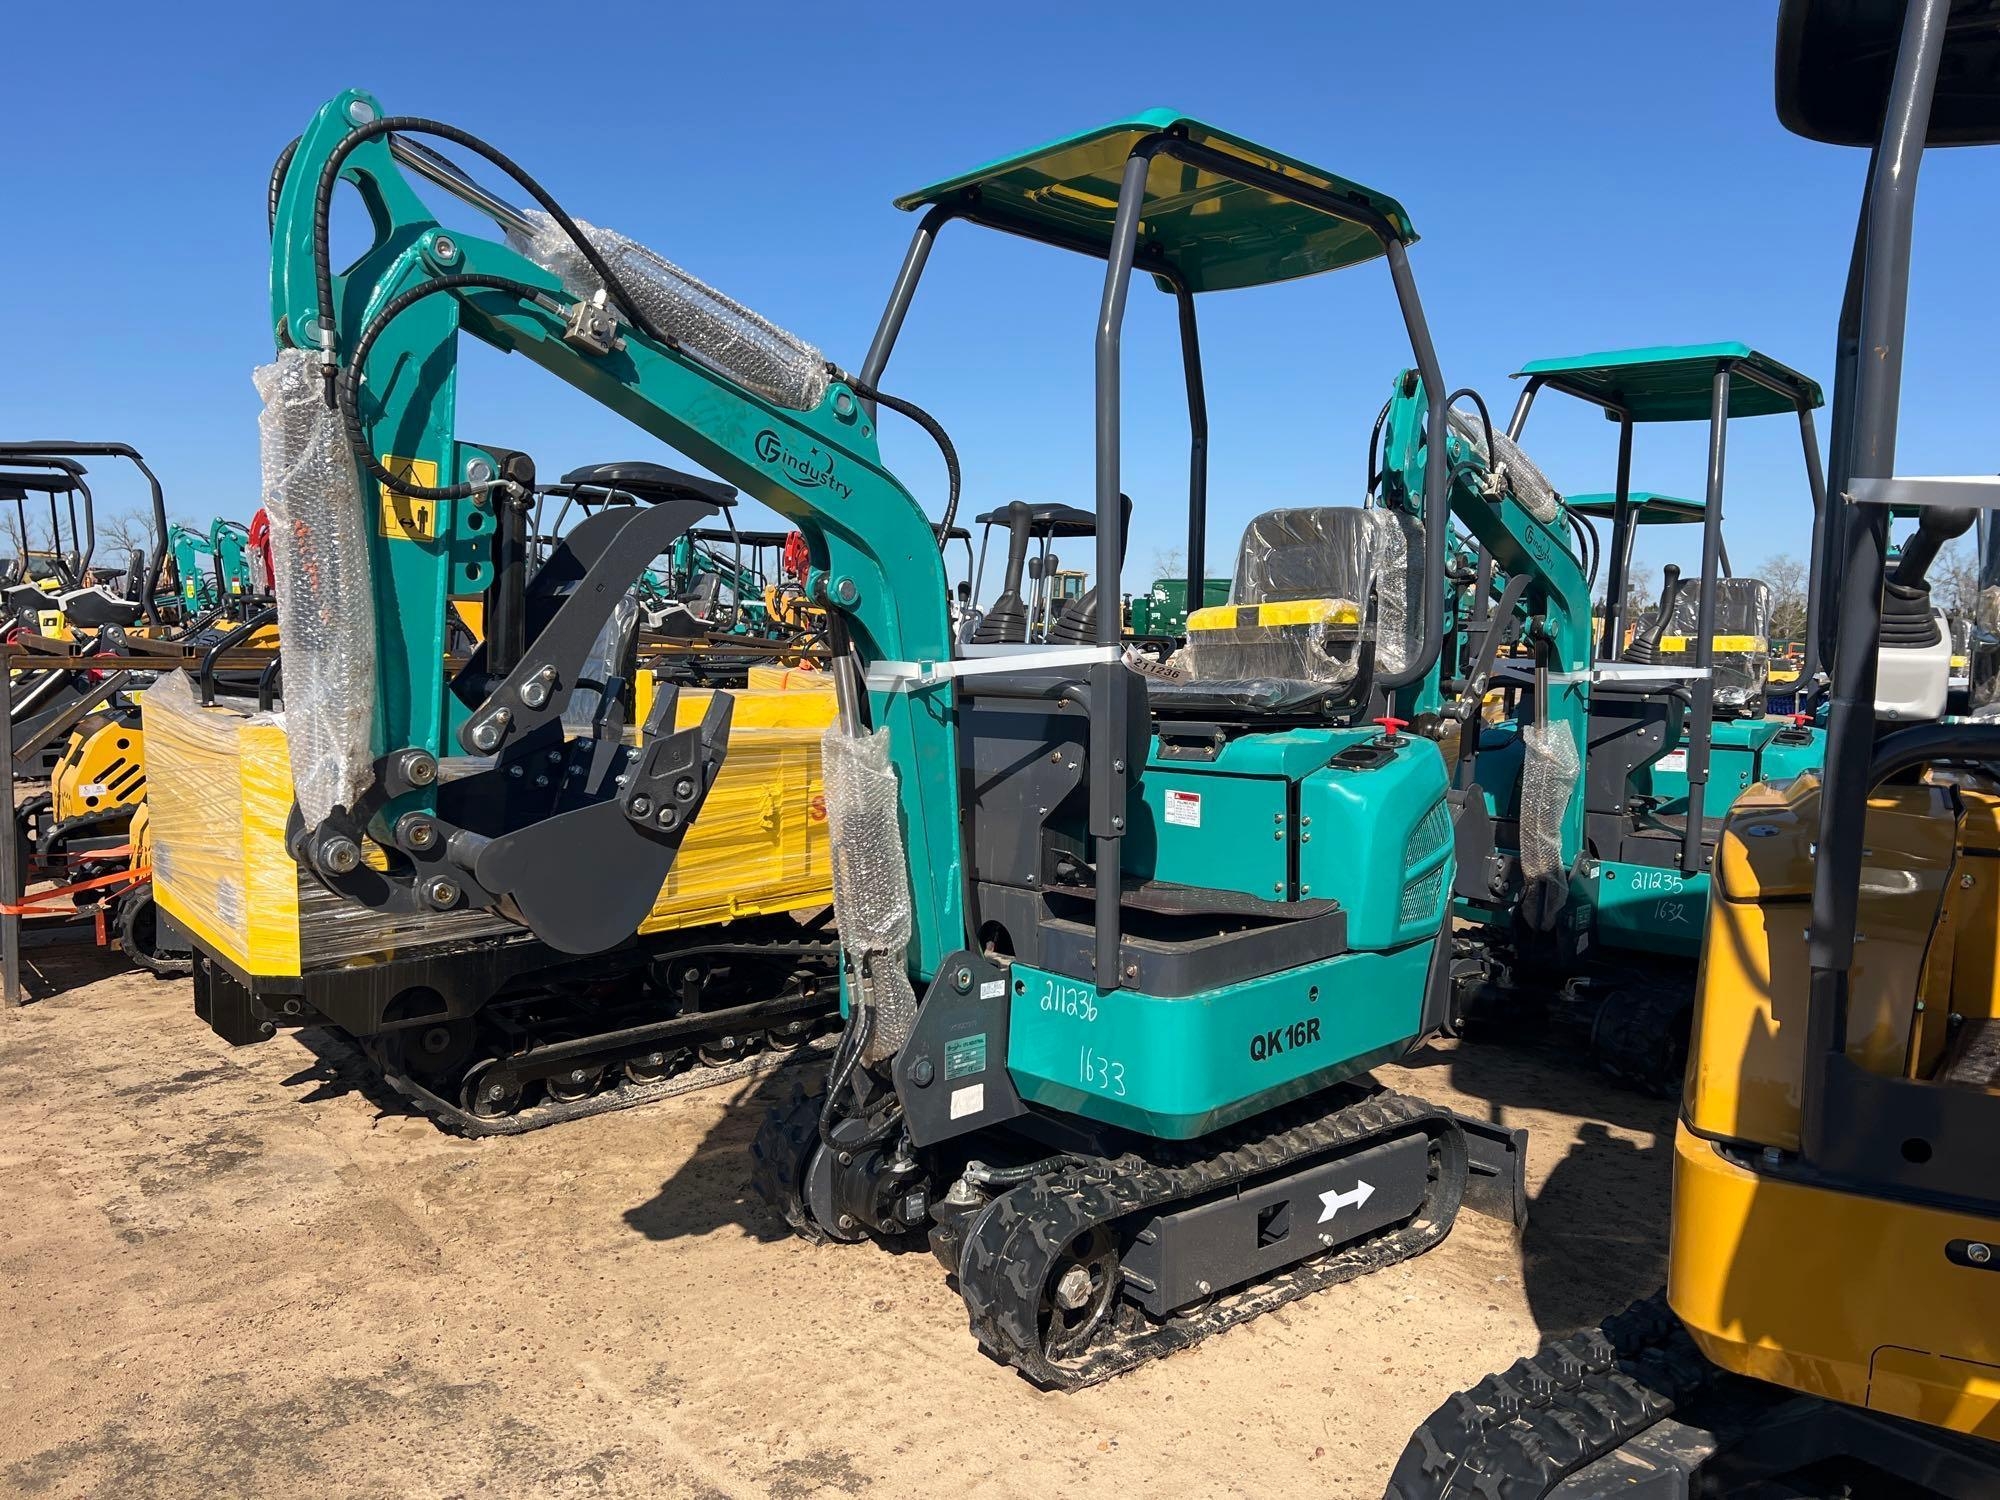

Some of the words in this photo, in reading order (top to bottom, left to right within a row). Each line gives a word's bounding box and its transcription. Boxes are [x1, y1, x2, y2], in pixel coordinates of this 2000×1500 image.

[782, 447, 853, 500] industry
[1134, 658, 1181, 679] 211236
[1631, 871, 1684, 895] 211235
[1654, 899, 1689, 924] 1632
[1040, 980, 1098, 1022] 211236
[1080, 1045, 1126, 1097] 1633
